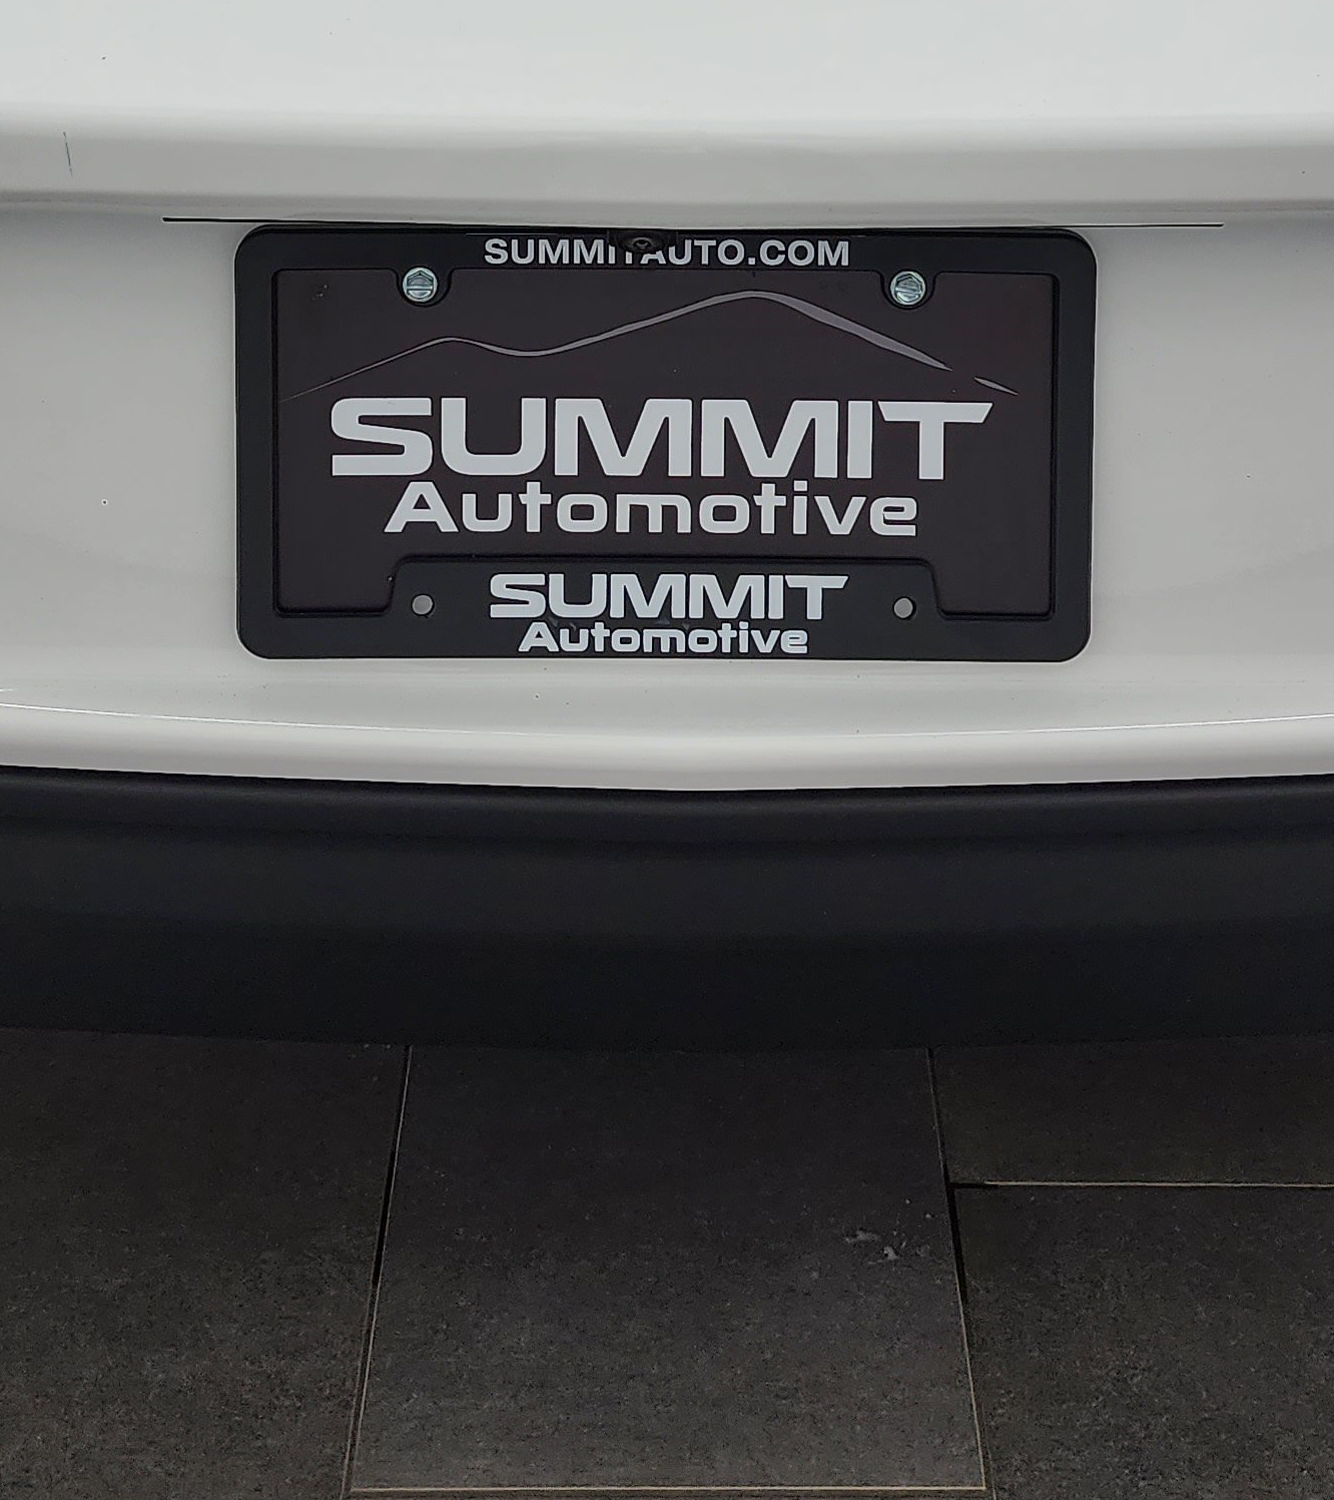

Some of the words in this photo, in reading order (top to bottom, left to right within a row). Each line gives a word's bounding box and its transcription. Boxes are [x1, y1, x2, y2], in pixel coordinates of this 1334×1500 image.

[330, 397, 993, 480] SUMMIT
[384, 480, 917, 537] Automotive
[489, 573, 849, 620] SUMMIT
[518, 621, 808, 654] Automotive
